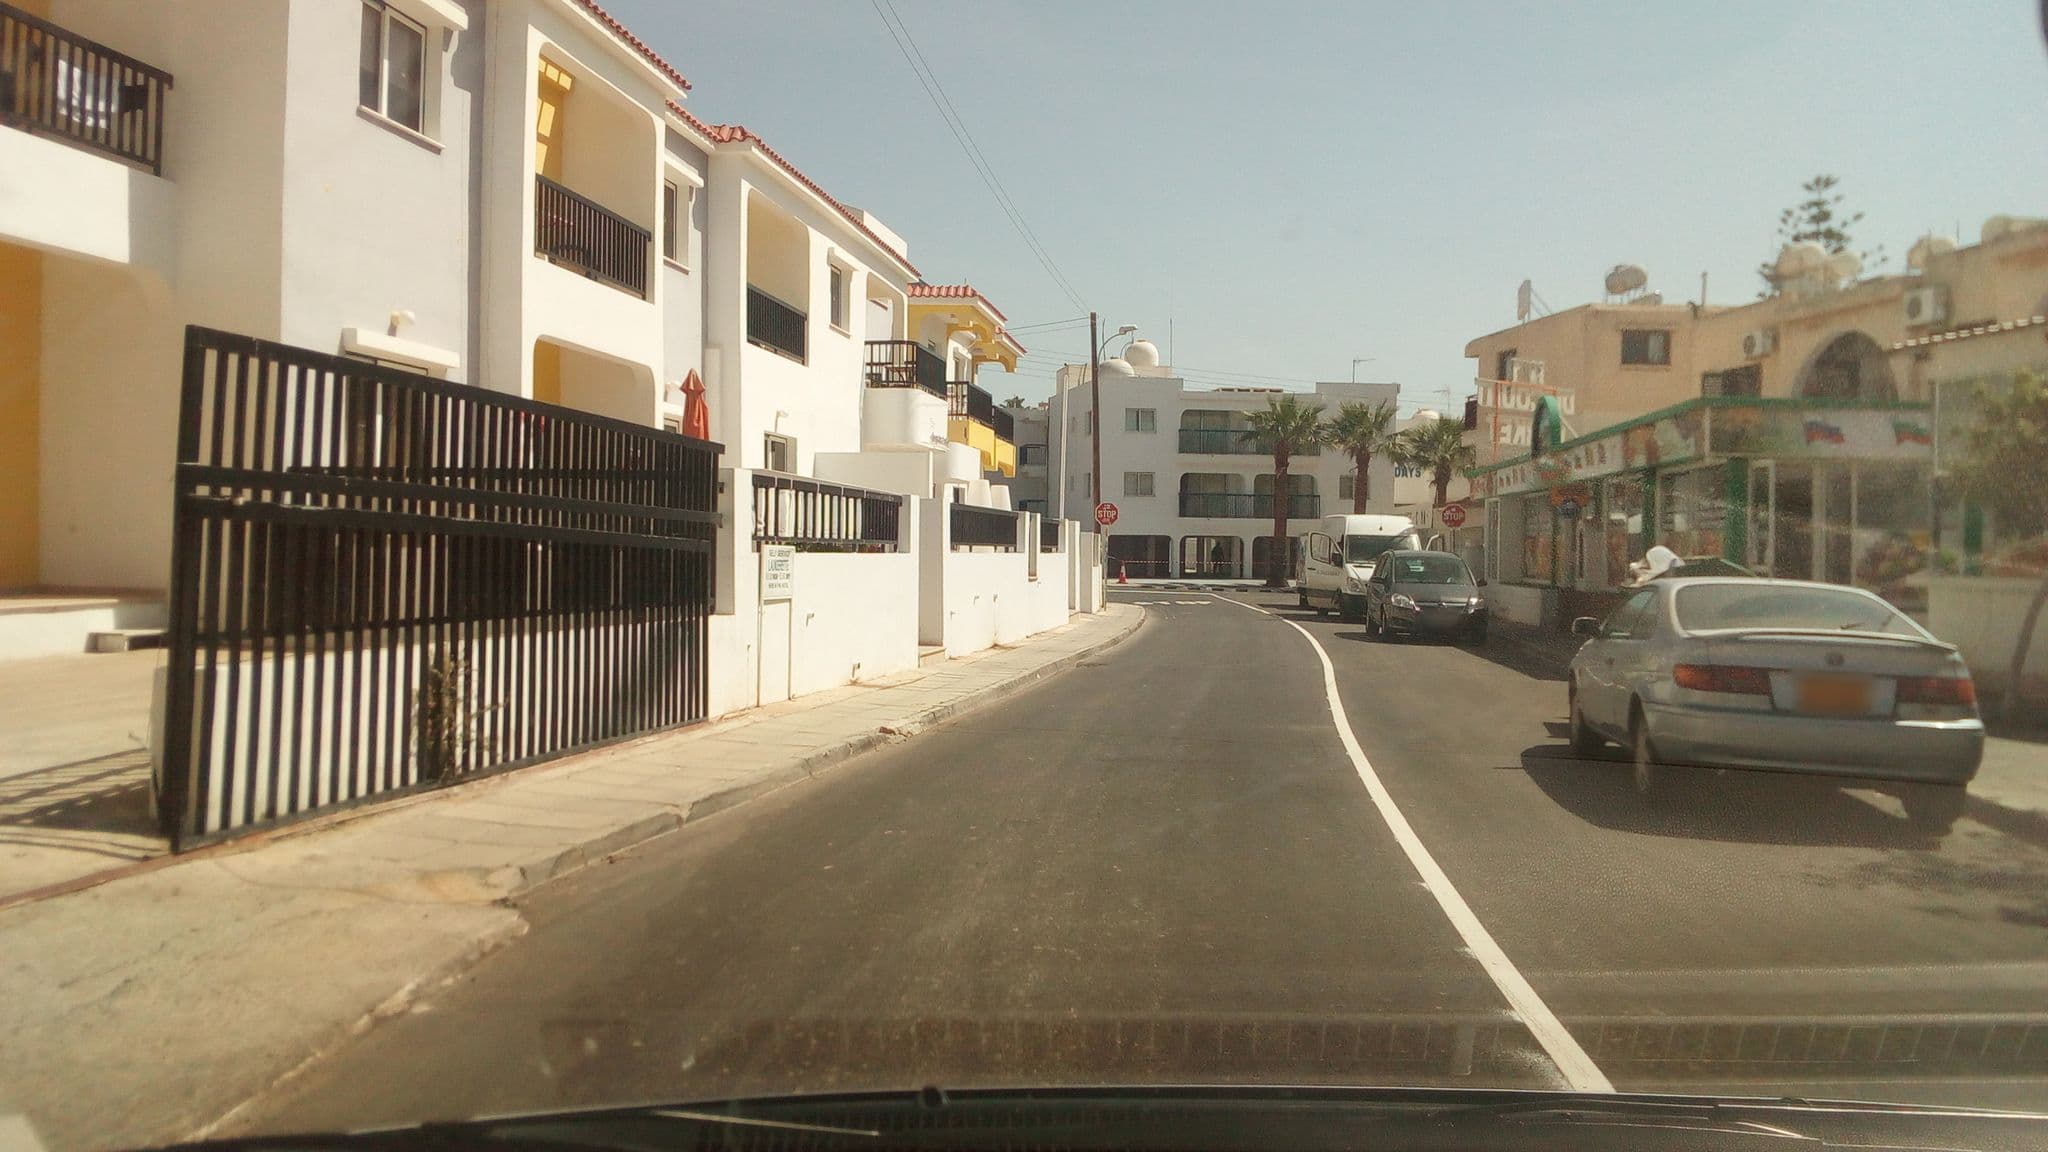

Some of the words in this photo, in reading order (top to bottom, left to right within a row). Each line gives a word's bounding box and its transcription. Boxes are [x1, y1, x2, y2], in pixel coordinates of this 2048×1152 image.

[1394, 466, 1421, 478] DAYS
[1097, 510, 1117, 519] STOP
[1443, 512, 1464, 521] STOP
